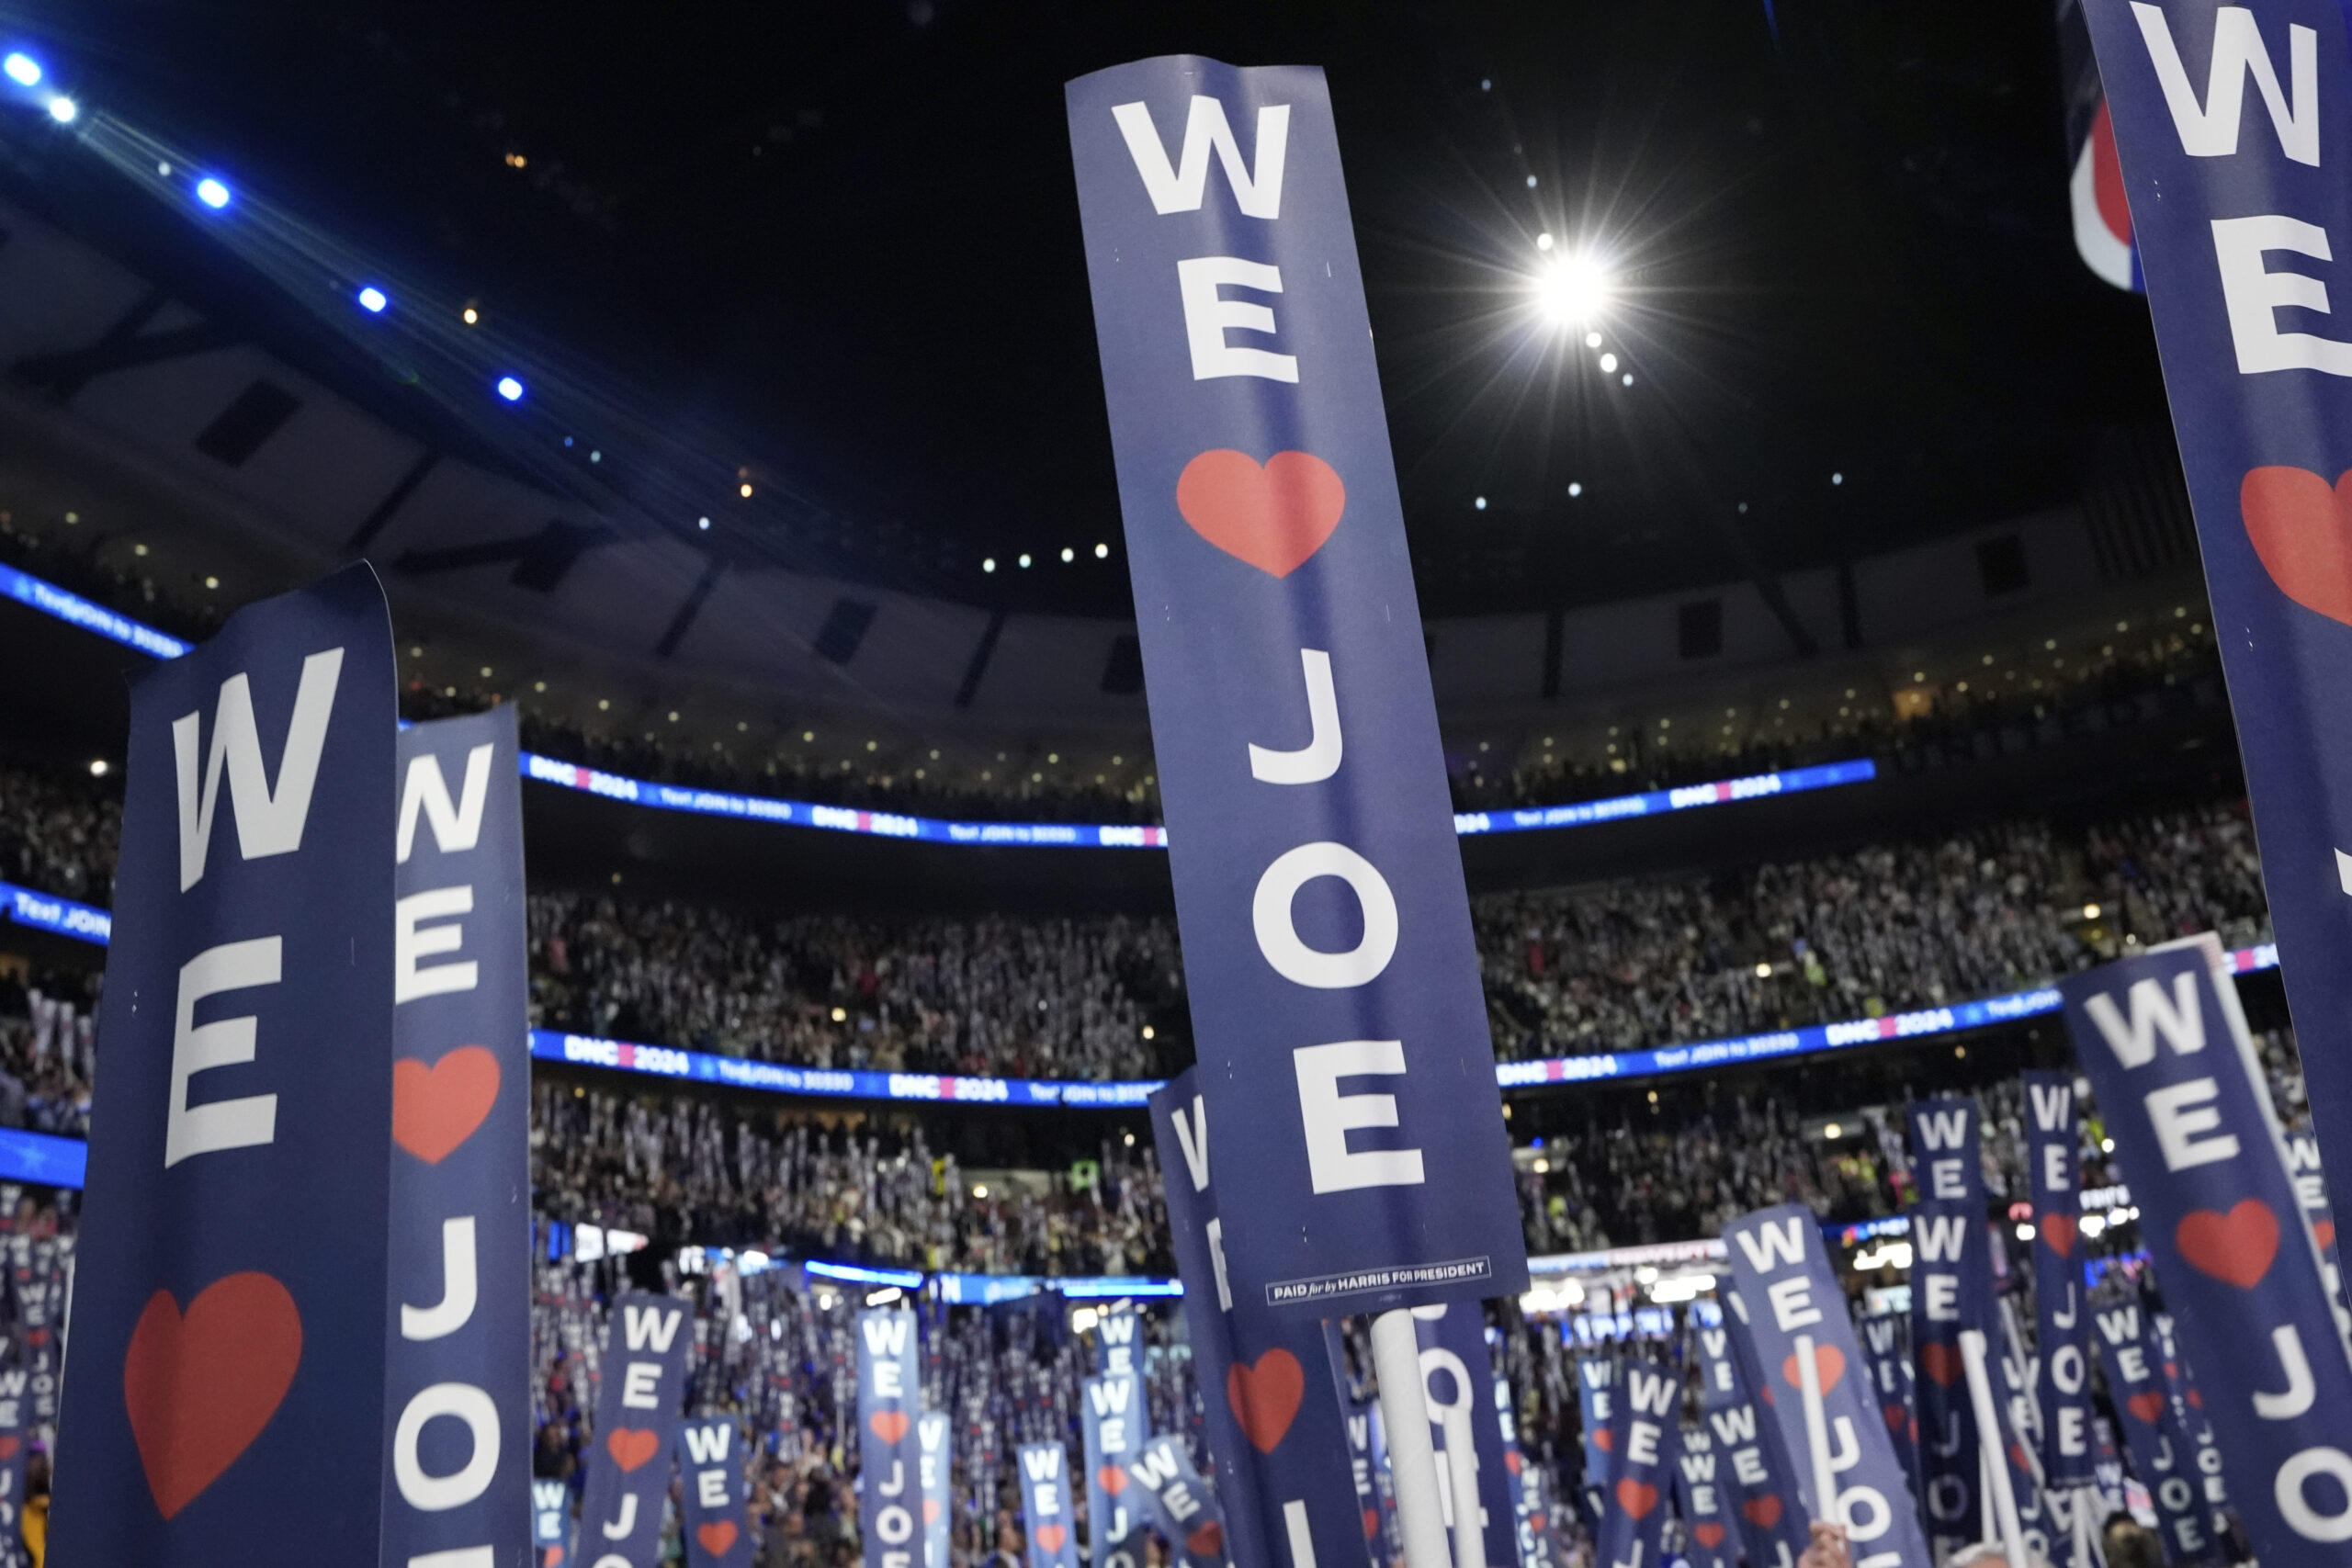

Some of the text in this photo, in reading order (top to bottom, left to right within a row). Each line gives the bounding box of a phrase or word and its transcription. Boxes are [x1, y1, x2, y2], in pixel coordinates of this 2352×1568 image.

[2129, 0, 2352, 377] WE
[1111, 95, 1425, 1194] WE JOE
[165, 647, 345, 1169] WE
[2083, 970, 2241, 1173] WE
[393, 743, 501, 1568] WE JO
[1917, 1108, 1967, 1200] WE
[1274, 1260, 1485, 1301] PAID for by HARRIS FOR PRESIDENT
[1736, 1216, 1823, 1333] WE
[1914, 1214, 1967, 1322] WE
[2030, 1083, 2071, 1191] WE
[2052, 1280, 2086, 1456] JOE
[622, 1305, 683, 1410] WE
[862, 1319, 908, 1398] WE
[1100, 1314, 1136, 1374] WE
[1582, 1360, 1611, 1420] WE
[1089, 1379, 1131, 1454] WE
[1627, 1369, 1678, 1467] WE
[1710, 1404, 1769, 1486] WE
[2096, 1305, 2205, 1552] WE JOE
[533, 1482, 566, 1539] WE
[684, 1422, 731, 1508] WE
[1023, 1447, 1060, 1517] WE
[1130, 1442, 1201, 1523] WE
[1680, 1453, 1718, 1515] WE
